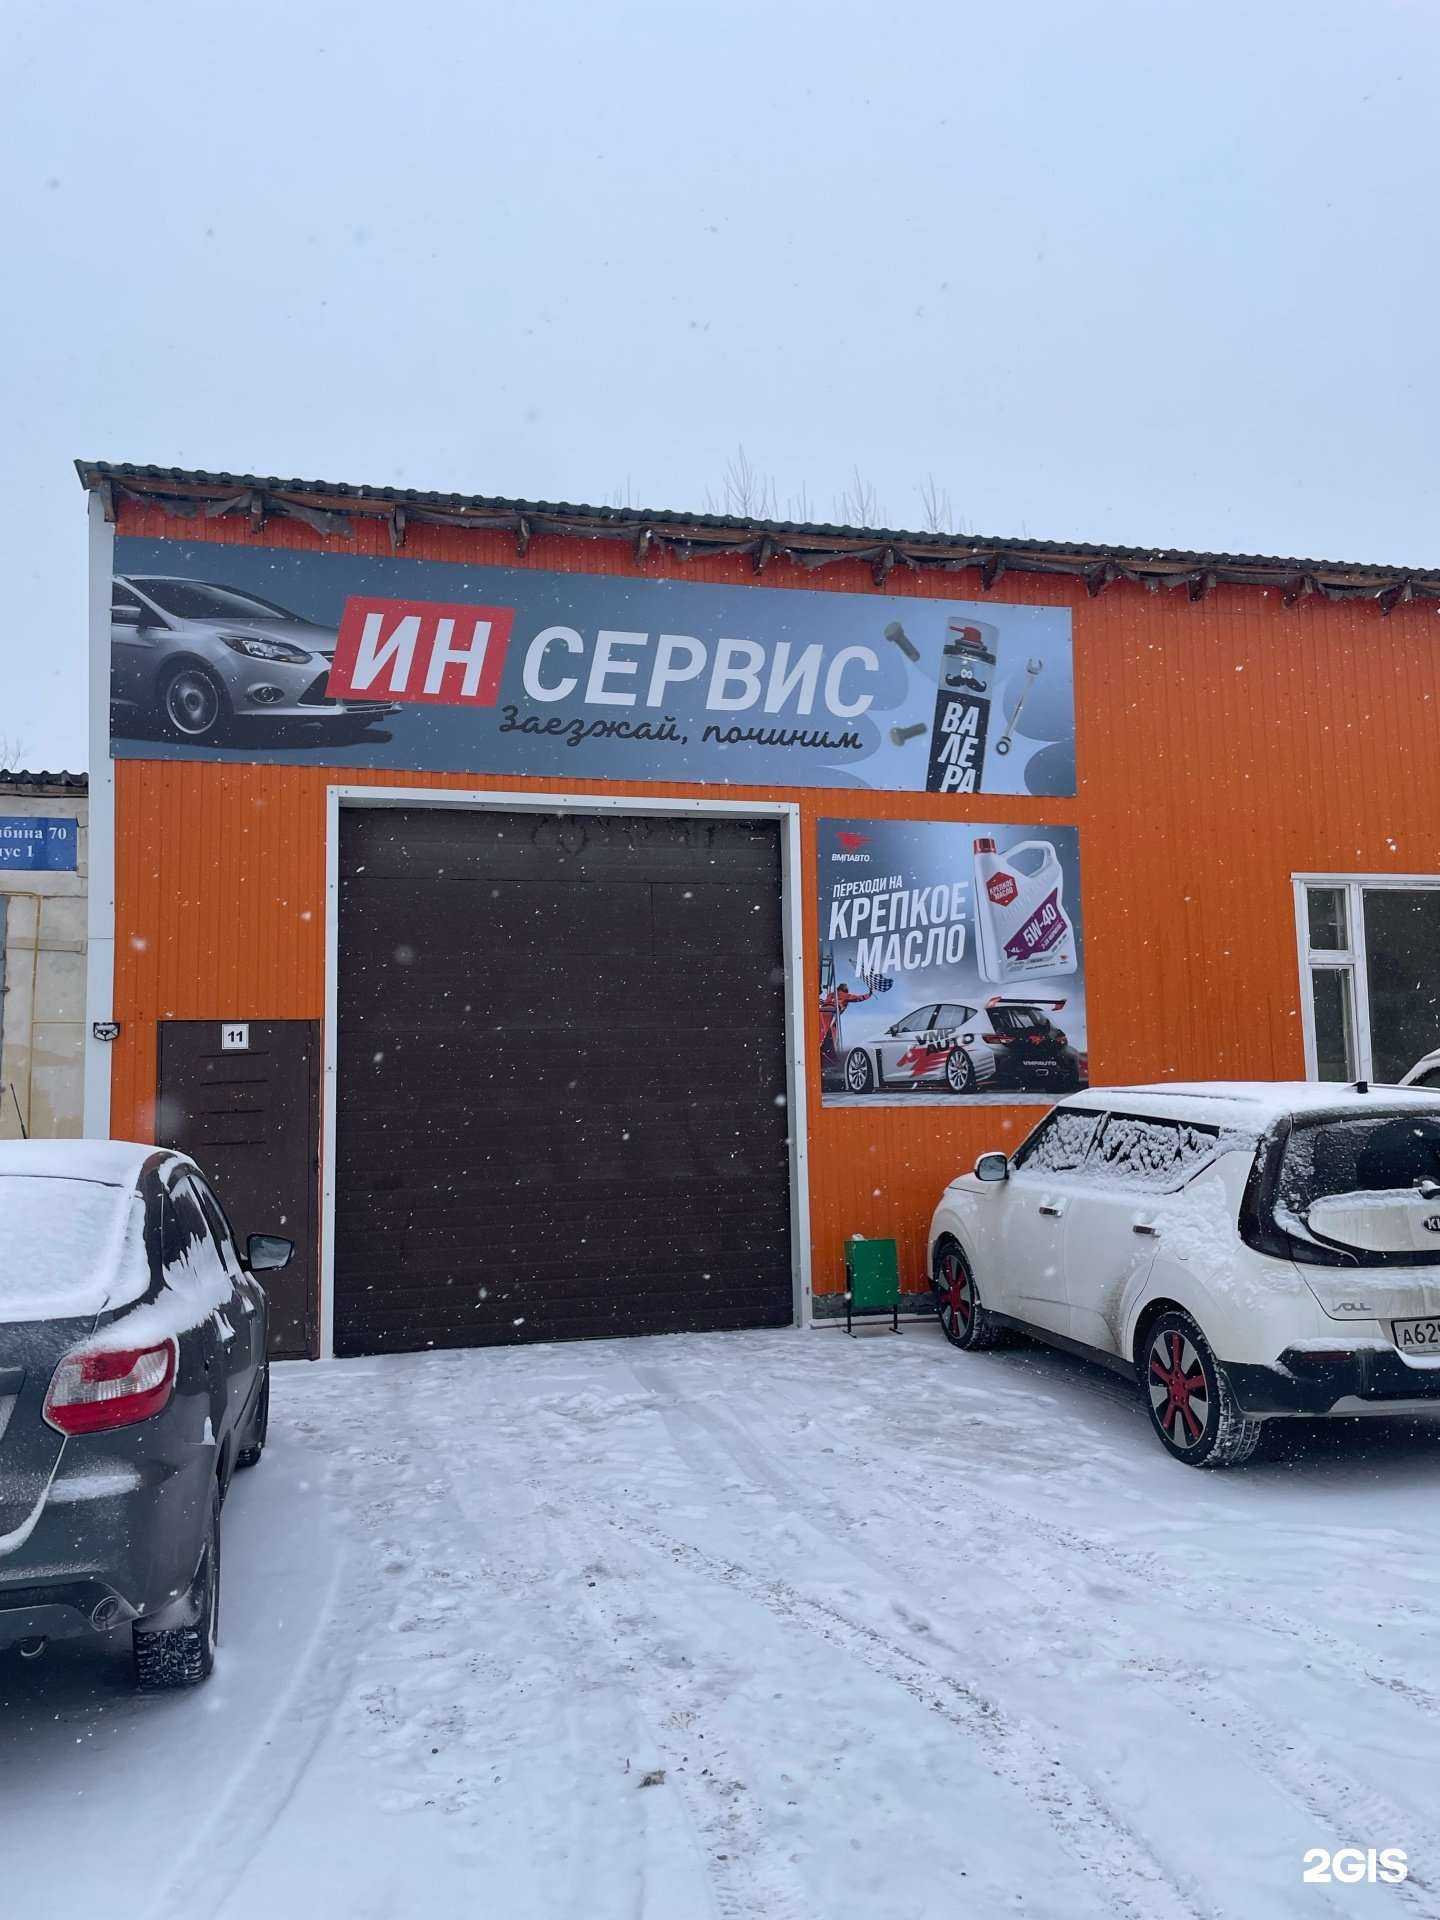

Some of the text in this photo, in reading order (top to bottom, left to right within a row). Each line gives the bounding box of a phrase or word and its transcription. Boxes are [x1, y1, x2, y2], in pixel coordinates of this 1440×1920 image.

[350, 613, 879, 718] ИН СЕРВИС
[499, 704, 864, 751] Заезжай, починим
[49, 827, 67, 840] 70
[27, 845, 33, 857] 1
[832, 853, 871, 863] ВМПАВТО
[833, 875, 903, 898] ПЕРЕХОДИ НА
[828, 881, 969, 941] КРЕПКОЕ
[1023, 903, 1056, 947] 5W-40
[855, 924, 966, 978] МАСЛО
[227, 1030, 243, 1042] 11
